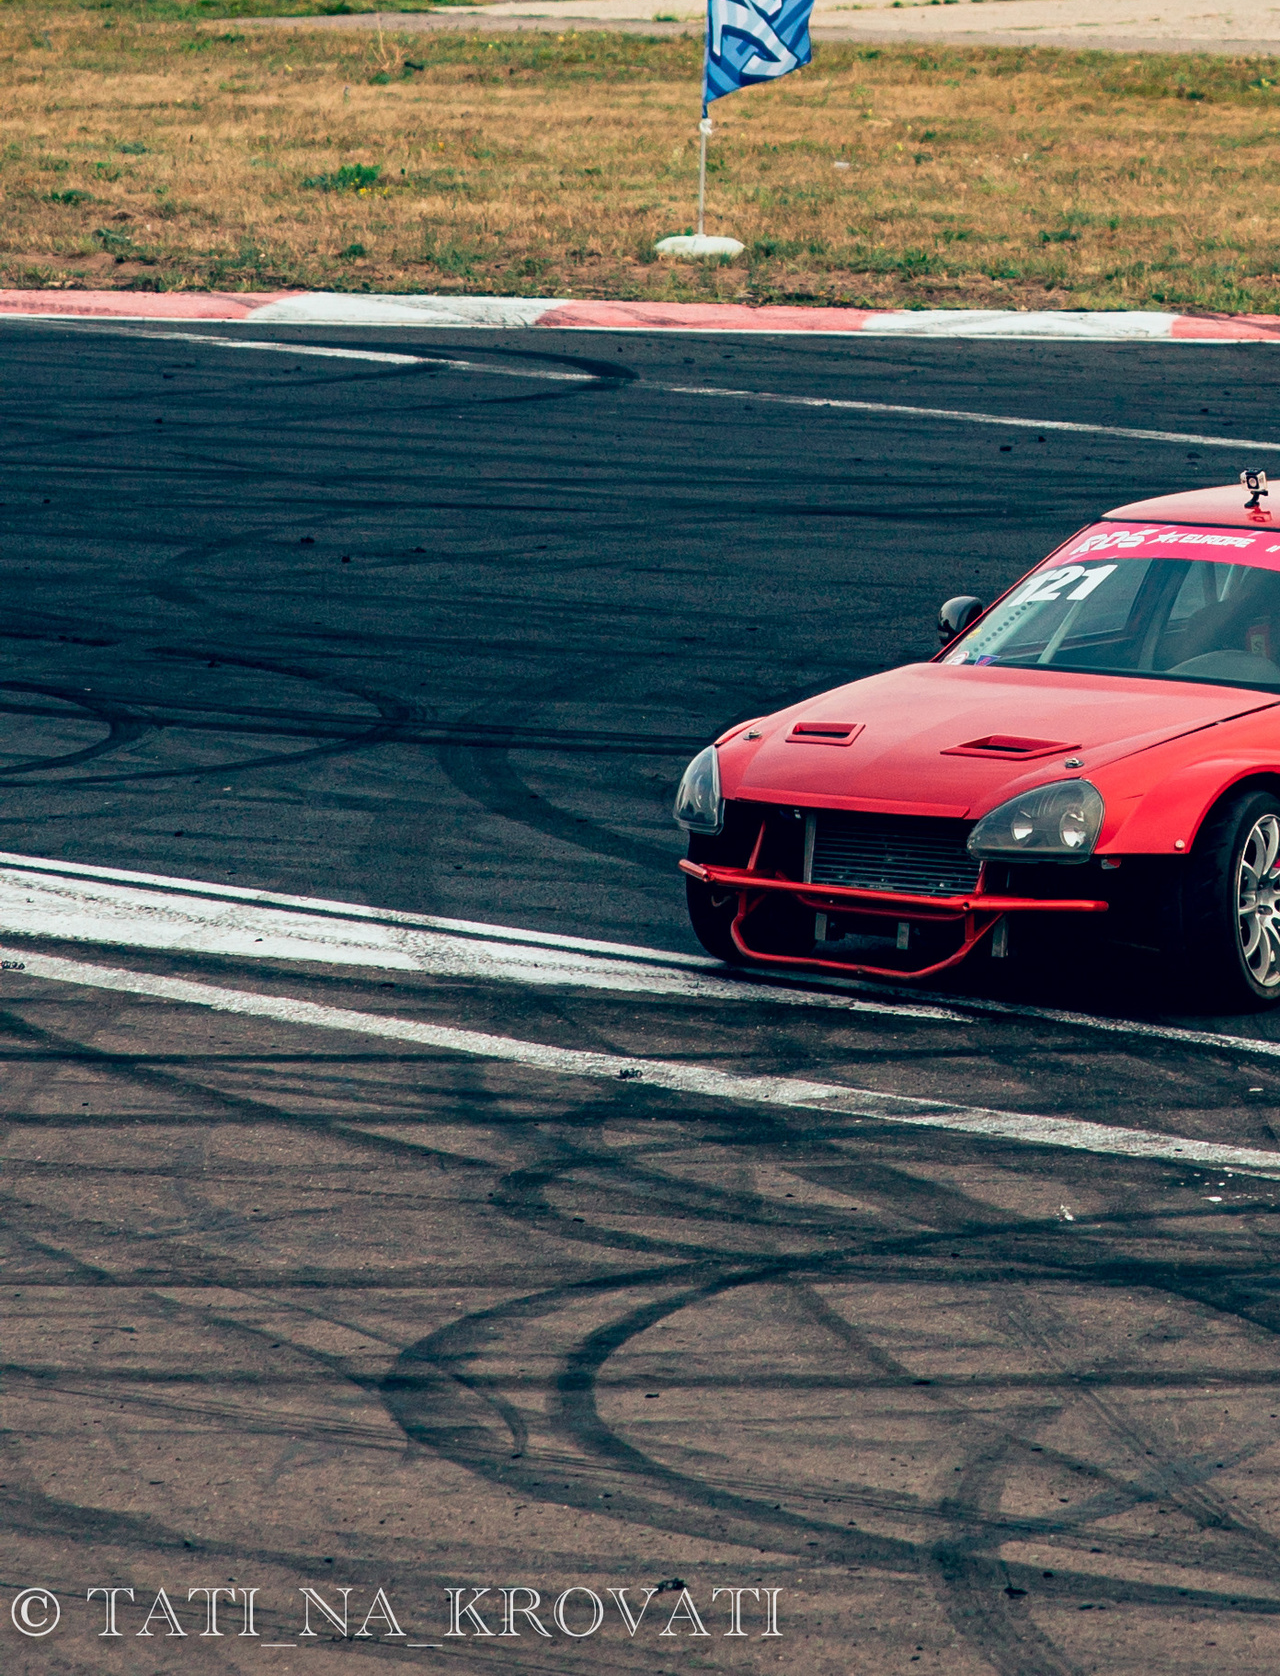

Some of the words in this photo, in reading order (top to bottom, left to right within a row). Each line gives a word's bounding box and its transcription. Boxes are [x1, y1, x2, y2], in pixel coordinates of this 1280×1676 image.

[1069, 529, 1160, 555] RDS
[1179, 534, 1256, 548] EUROPE
[1008, 565, 1118, 607] 121
